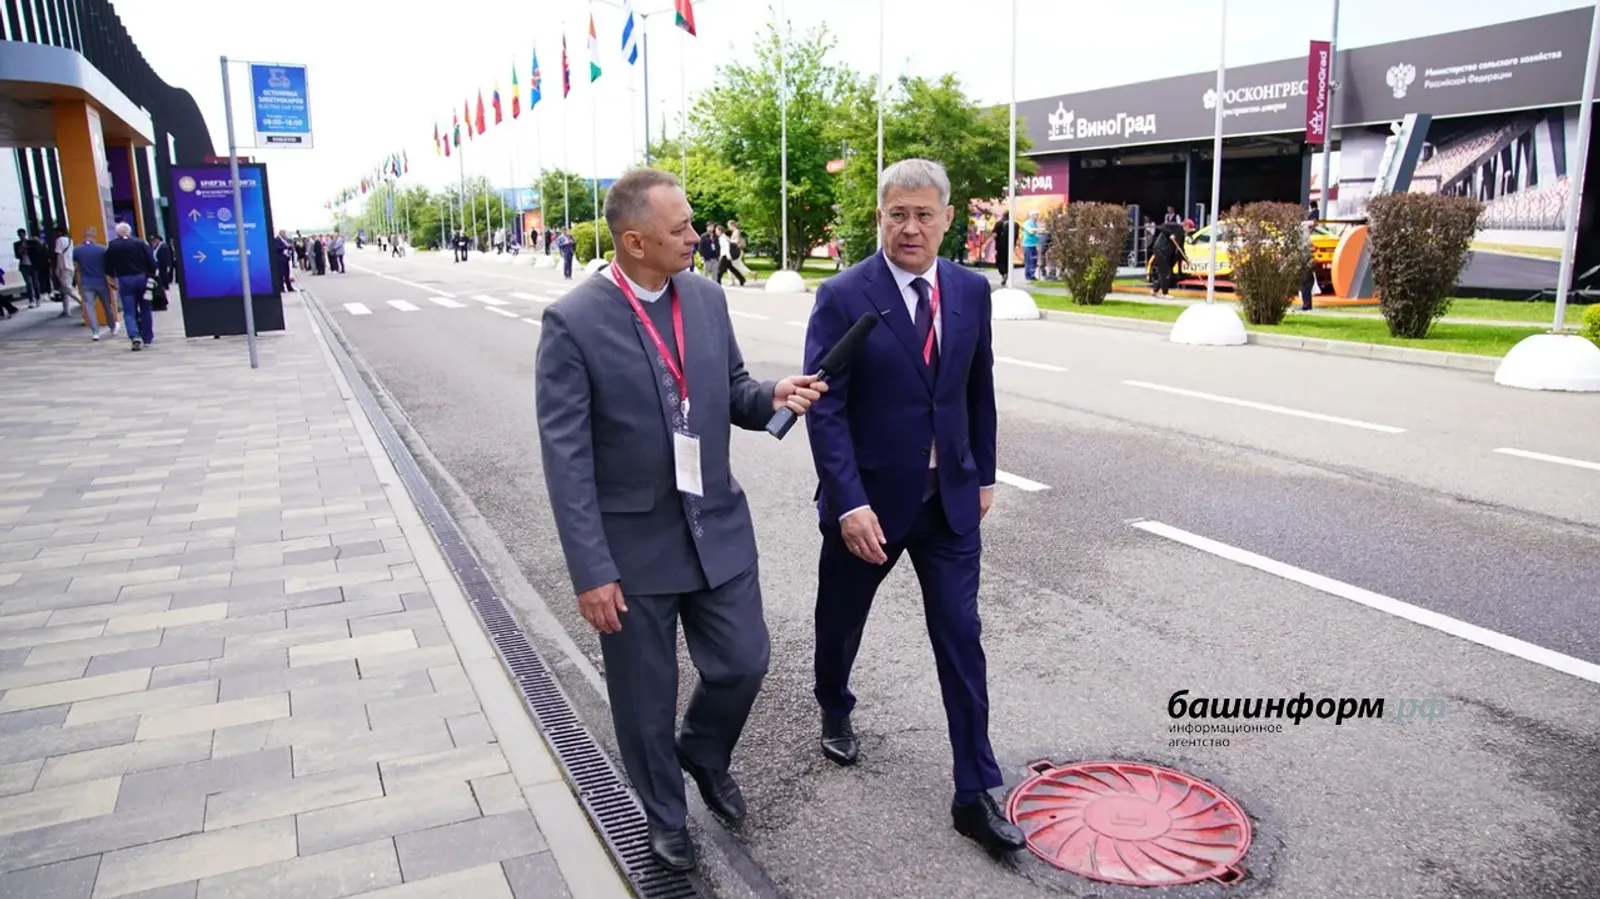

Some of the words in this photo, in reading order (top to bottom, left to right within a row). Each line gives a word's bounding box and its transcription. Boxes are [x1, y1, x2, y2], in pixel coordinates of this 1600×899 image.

[1425, 64, 1477, 77] Министерство
[1479, 58, 1517, 69] сельского
[1521, 51, 1562, 63] хозяйства
[1223, 80, 1309, 104] ОСКОНГРЕС
[1316, 50, 1328, 110] VinoGrad
[1424, 78, 1466, 88] Российской
[1468, 72, 1512, 83] Федерации
[1077, 112, 1156, 138] ВиноГрад
